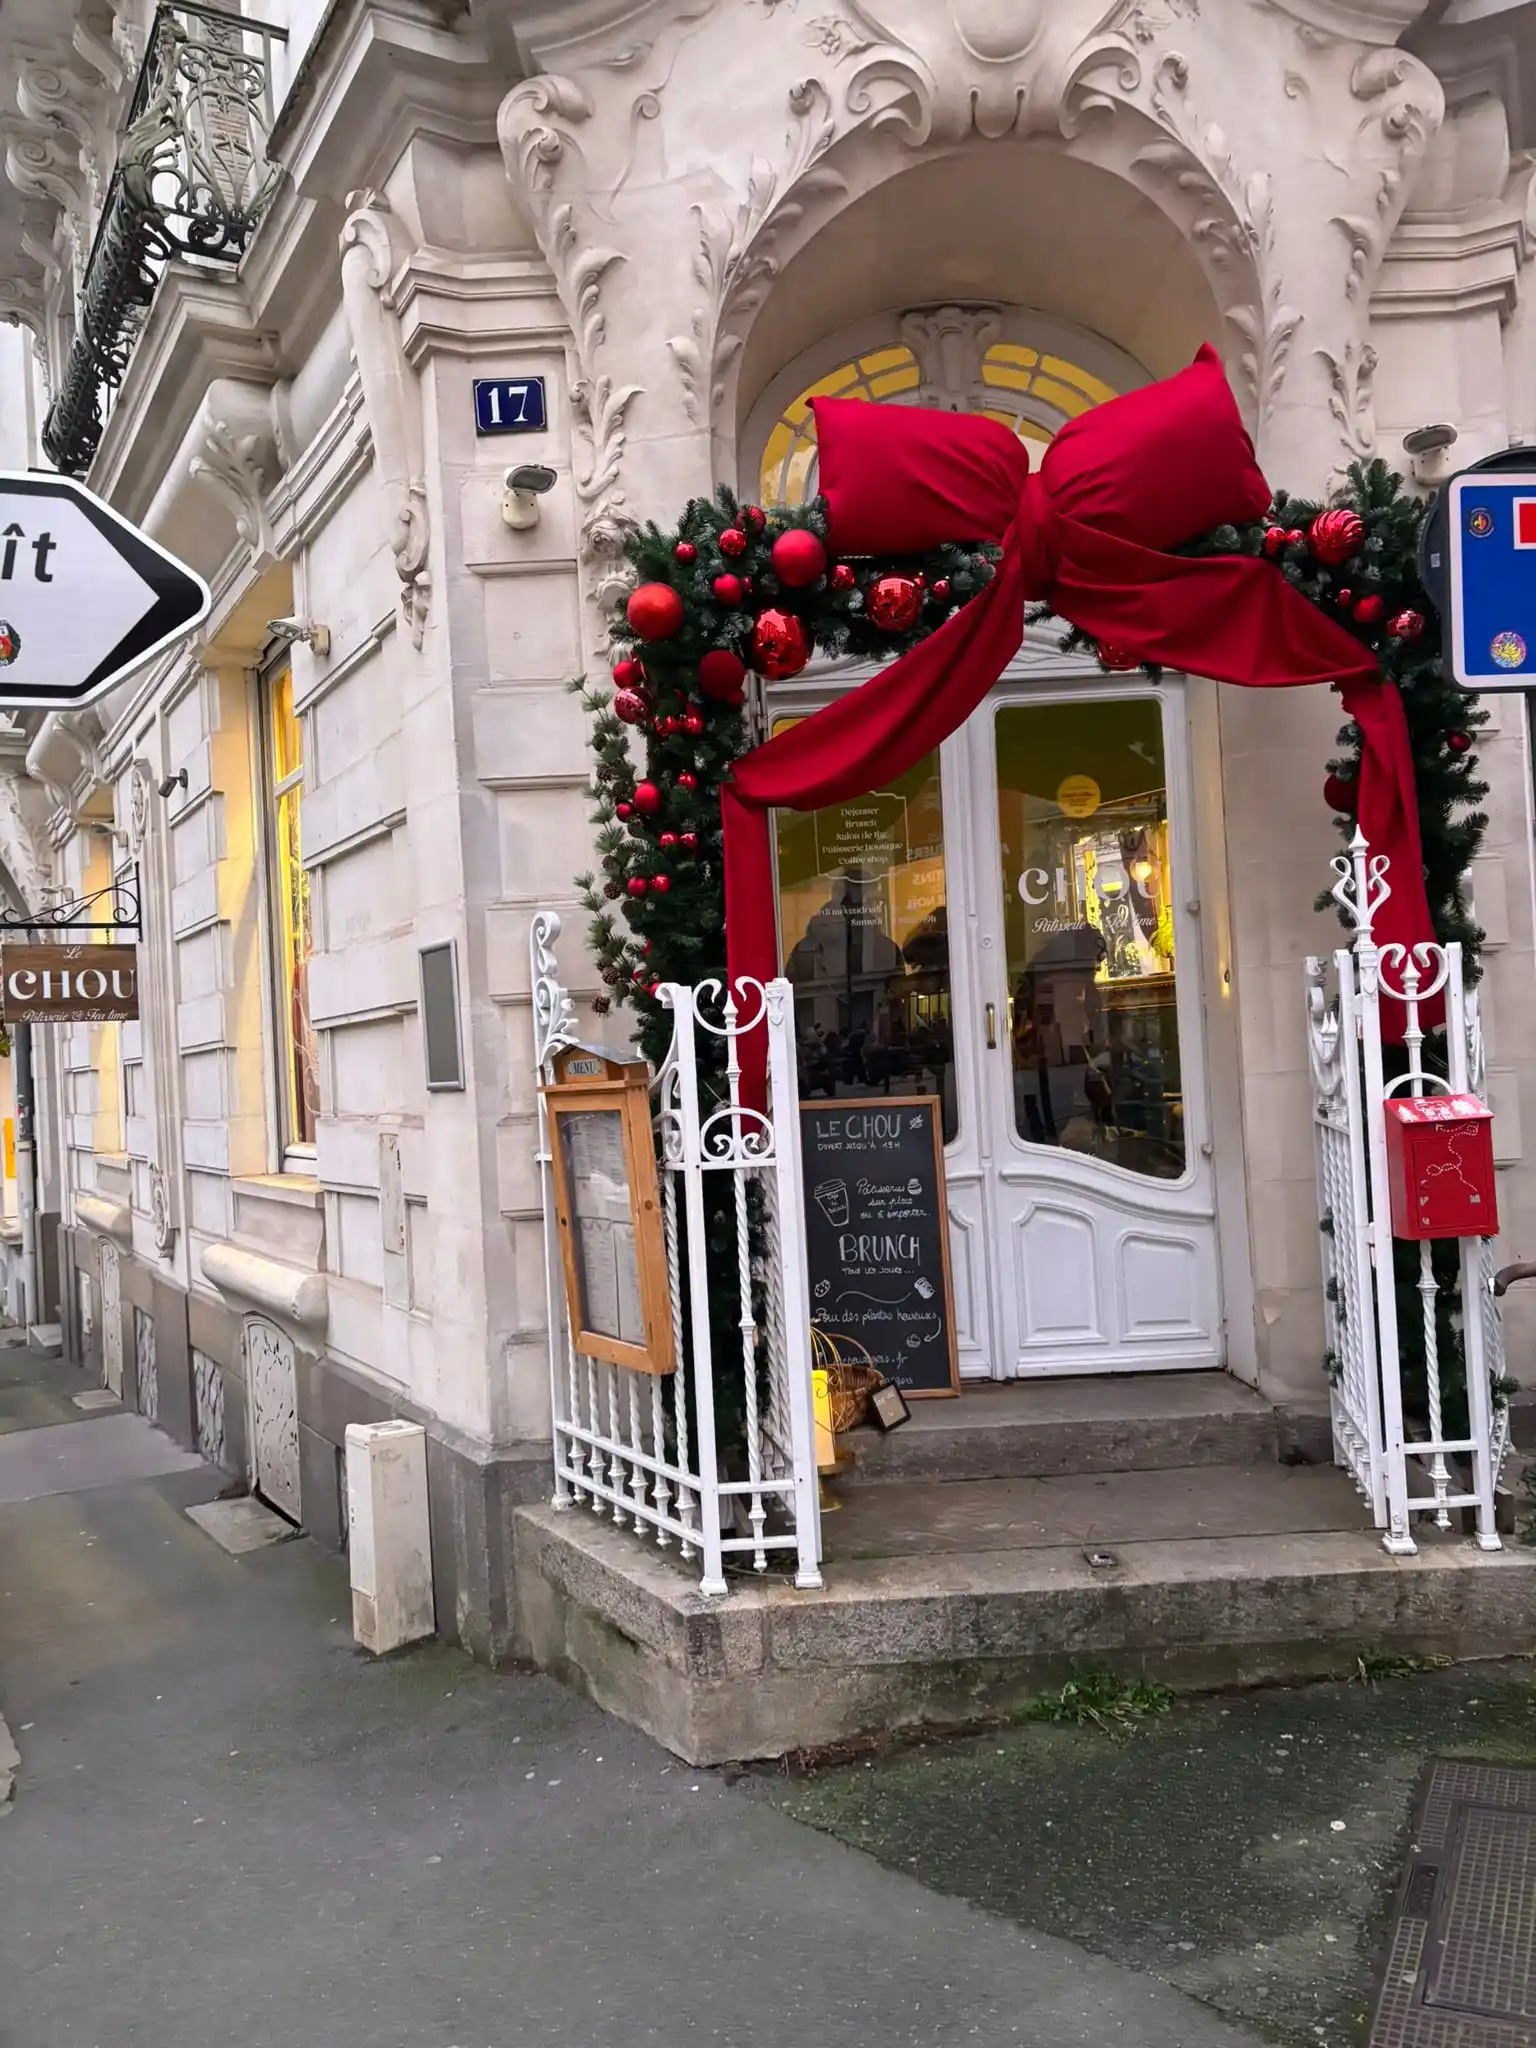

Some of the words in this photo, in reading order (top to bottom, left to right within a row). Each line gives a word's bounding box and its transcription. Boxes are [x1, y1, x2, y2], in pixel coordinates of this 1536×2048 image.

[488, 386, 528, 424] 17
[845, 820, 877, 829] Brunch
[861, 831, 872, 840] de
[63, 946, 82, 959] Le
[8, 969, 135, 1000] CHOU
[71, 1011, 83, 1020] &
[85, 1008, 106, 1020] Tea
[572, 1061, 596, 1074] MENU
[816, 1120, 841, 1138] LE
[845, 1114, 901, 1139] CHOU
[817, 1142, 842, 1150] OUVERT
[868, 1198, 886, 1206] sur
[839, 1234, 920, 1267] BRUNCH
